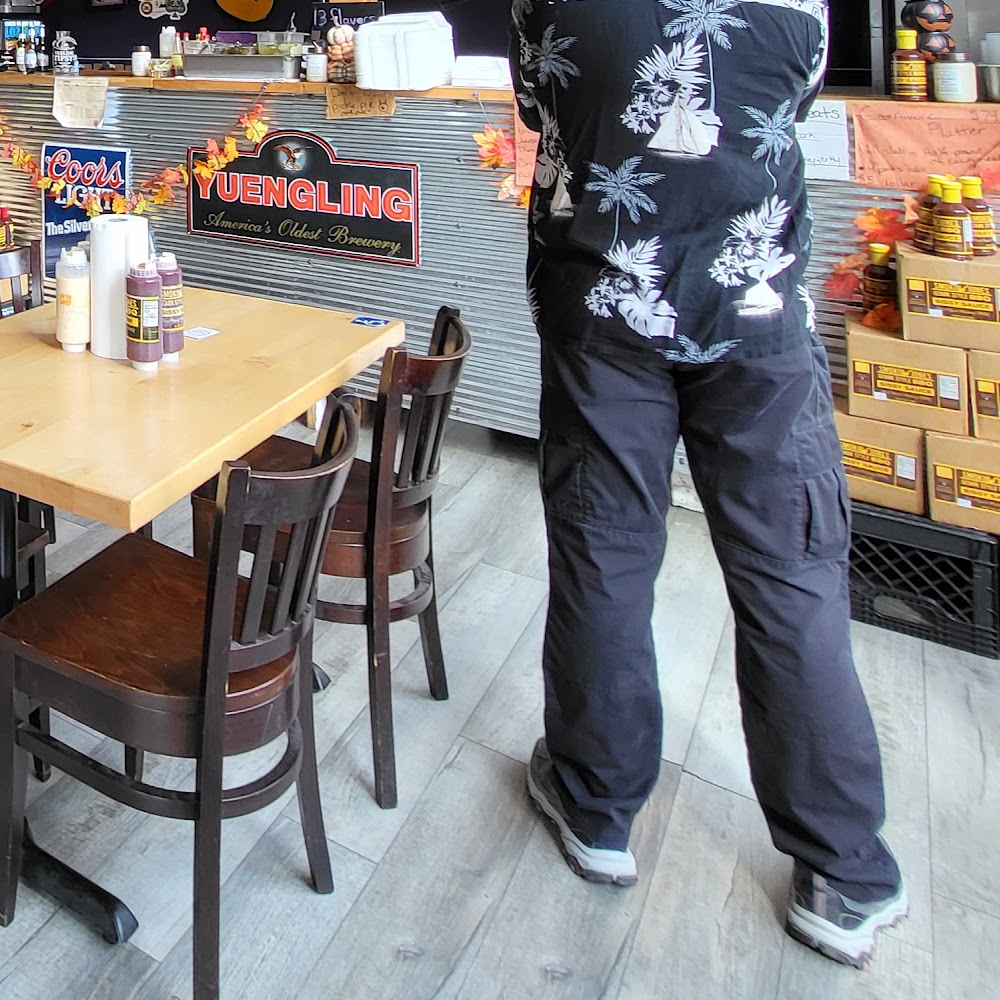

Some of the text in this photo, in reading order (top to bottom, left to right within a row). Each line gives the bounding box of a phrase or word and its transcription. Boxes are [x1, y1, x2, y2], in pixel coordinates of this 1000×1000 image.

[45, 149, 124, 188] Coors
[194, 171, 413, 222] YUENGLING
[203, 211, 402, 256] America's Oldest Brewery
